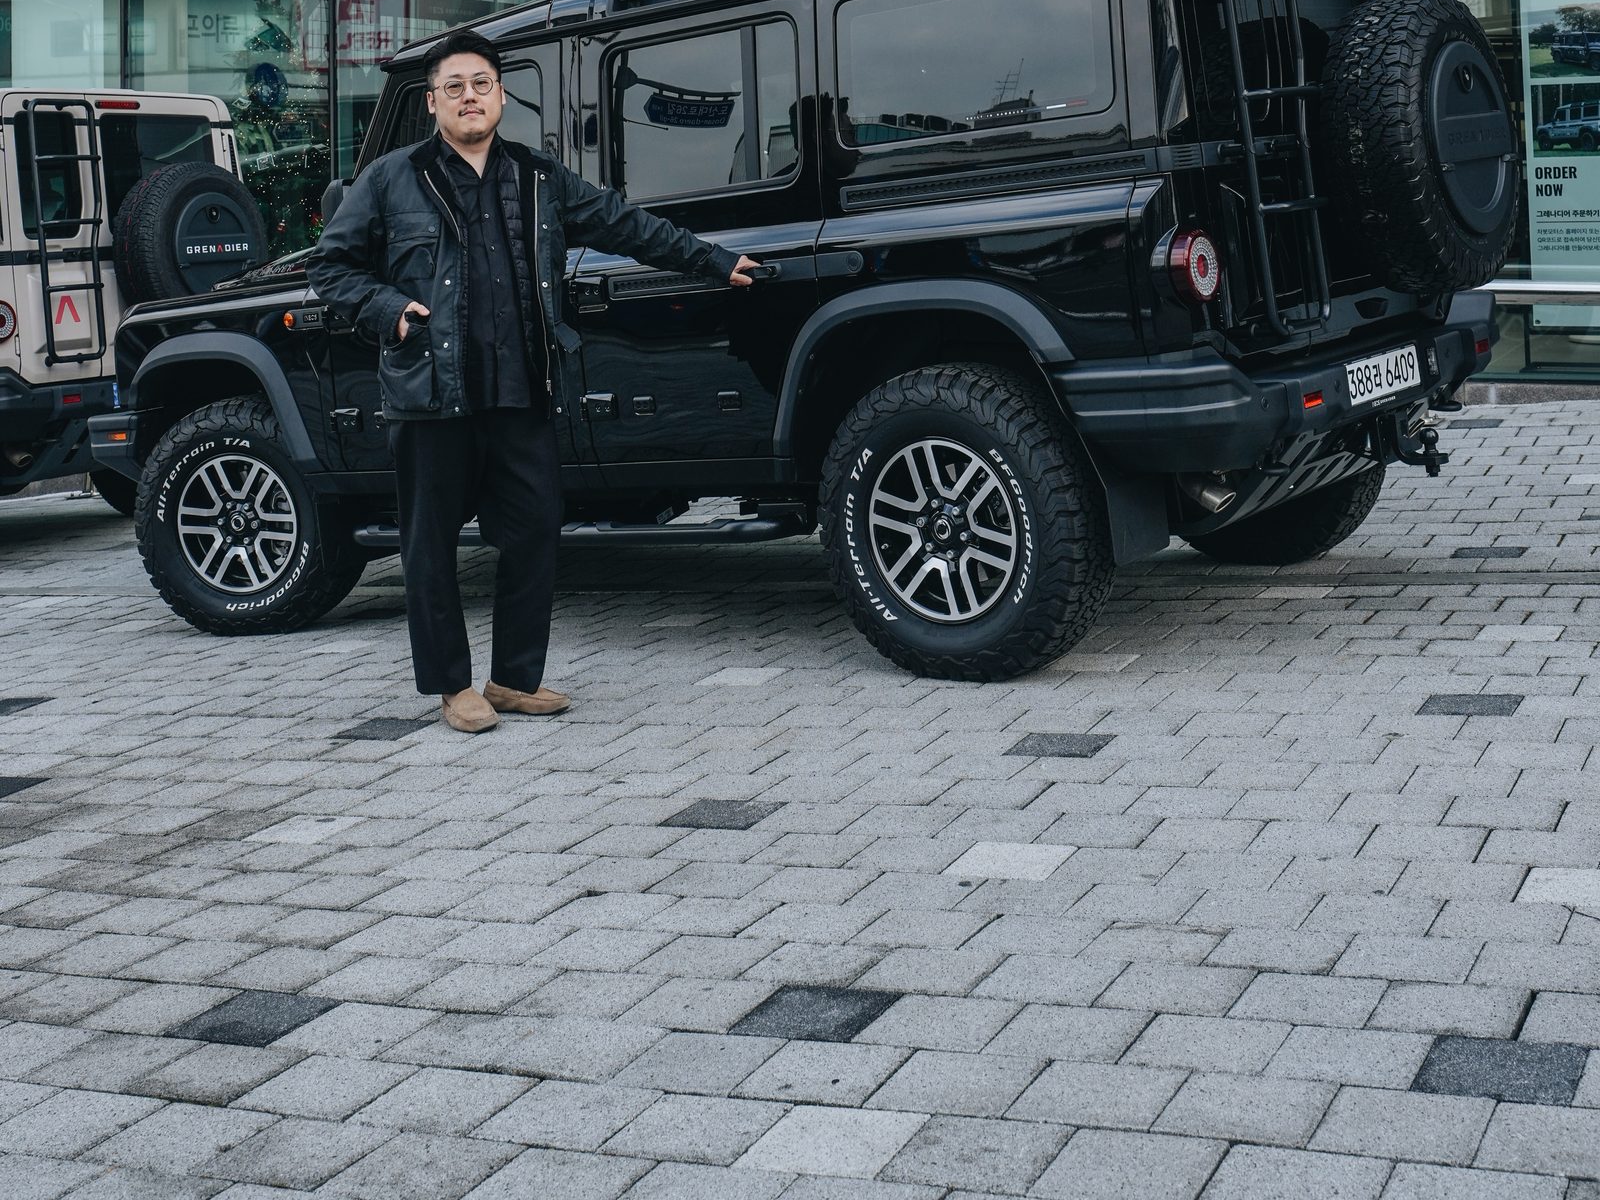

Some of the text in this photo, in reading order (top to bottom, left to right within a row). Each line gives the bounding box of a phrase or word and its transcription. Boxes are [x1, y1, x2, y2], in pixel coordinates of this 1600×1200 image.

[1535, 166, 1577, 180] ORDER
[1535, 183, 1563, 197] NOW
[1536, 210, 1571, 218] 그레나디어
[186, 243, 249, 254] GRENADIER
[1347, 351, 1415, 400] 388라 6409
[156, 437, 251, 523] All-Terrain T/A
[845, 447, 898, 622] All-Terrain T/A
[988, 448, 1034, 605] BFGoodrich
[225, 541, 310, 612] BFGoodrich
